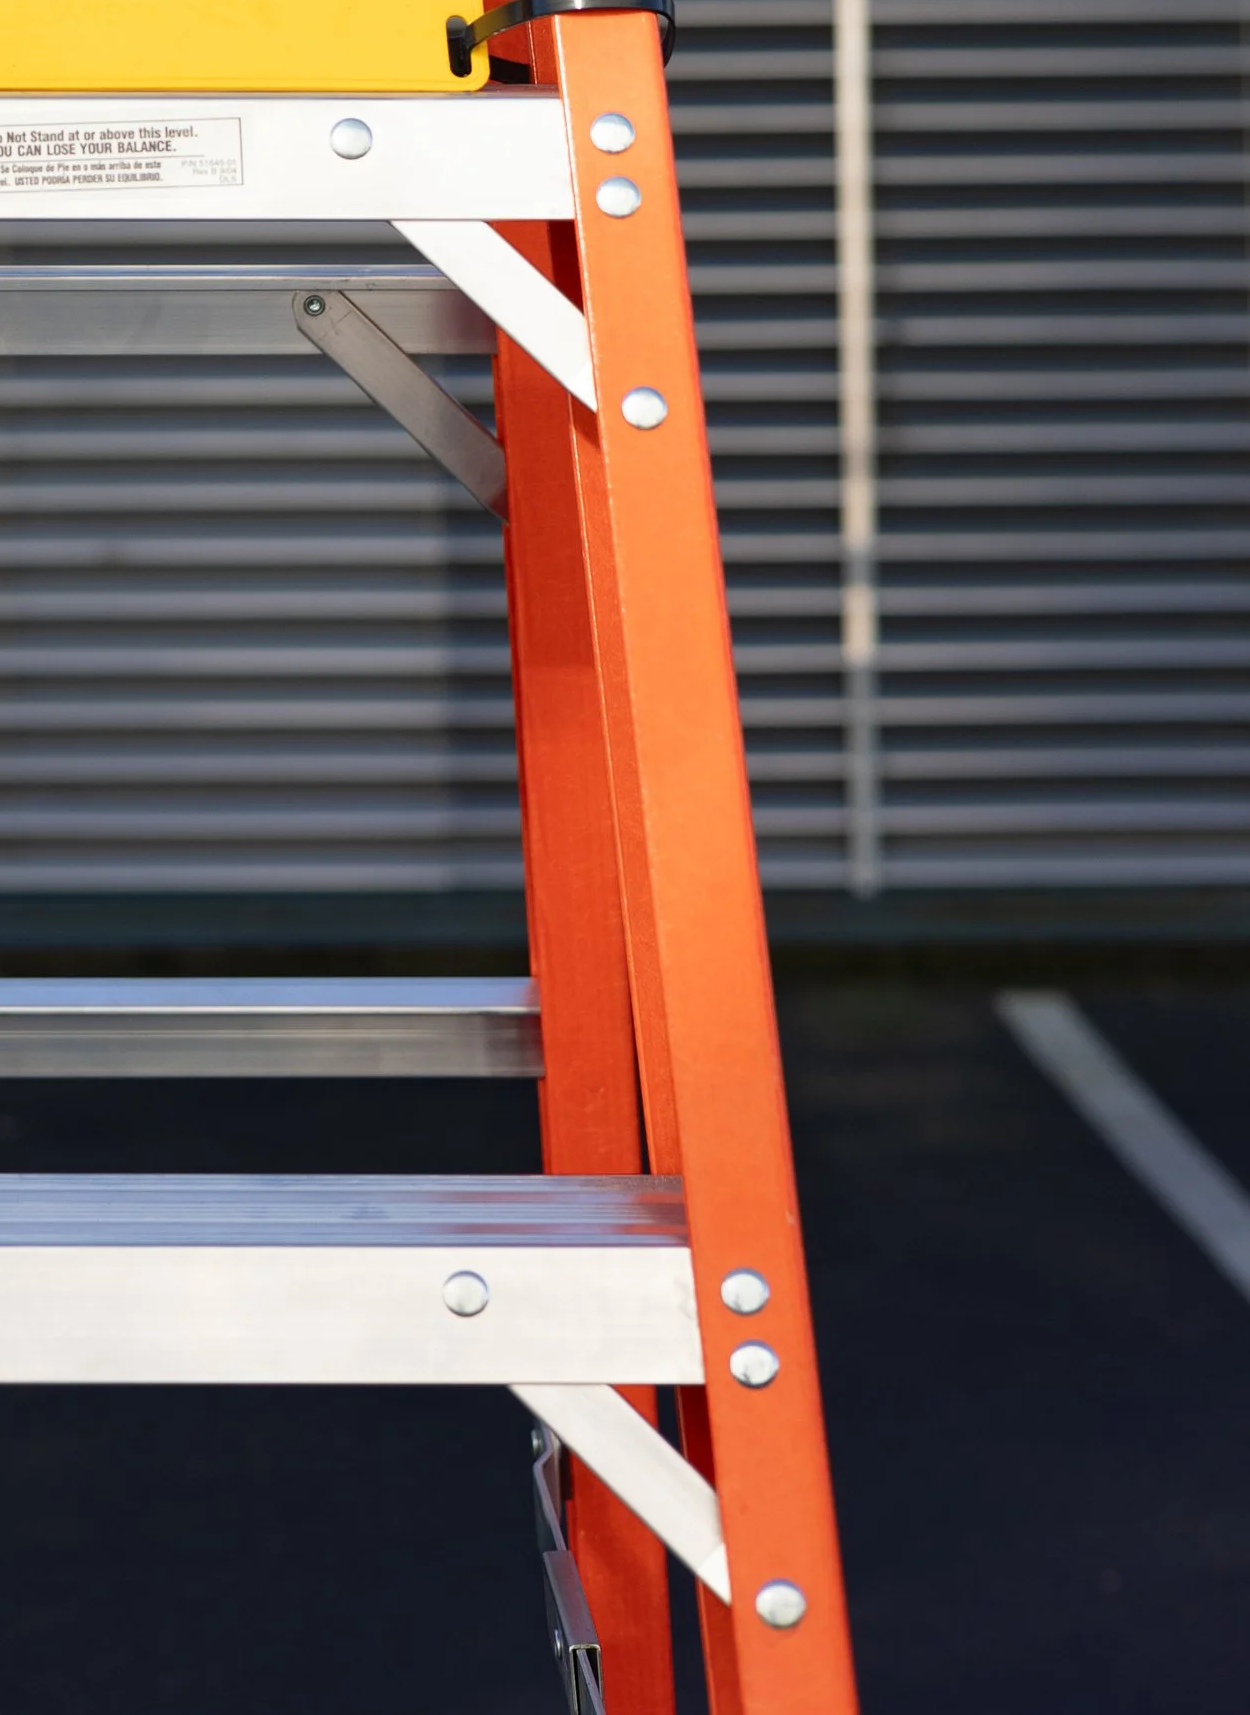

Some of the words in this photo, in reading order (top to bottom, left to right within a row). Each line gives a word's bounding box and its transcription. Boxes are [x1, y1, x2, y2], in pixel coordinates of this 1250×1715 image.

[7, 131, 26, 143] Not
[30, 130, 64, 142] Stand
[68, 130, 80, 141] at
[84, 132, 95, 141] or
[100, 128, 135, 140] above
[139, 127, 161, 139] this
[165, 126, 198, 138] level.
[17, 145, 42, 157] CAN
[47, 143, 76, 156] LOSE
[80, 142, 112, 155] YOUR
[117, 140, 177, 153] BALANCE.
[0, 165, 9, 173] Se
[46, 163, 54, 172] de
[145, 159, 161, 169] este
[14, 175, 39, 186] USTED
[73, 173, 103, 184] PERDER
[105, 172, 115, 182] SU
